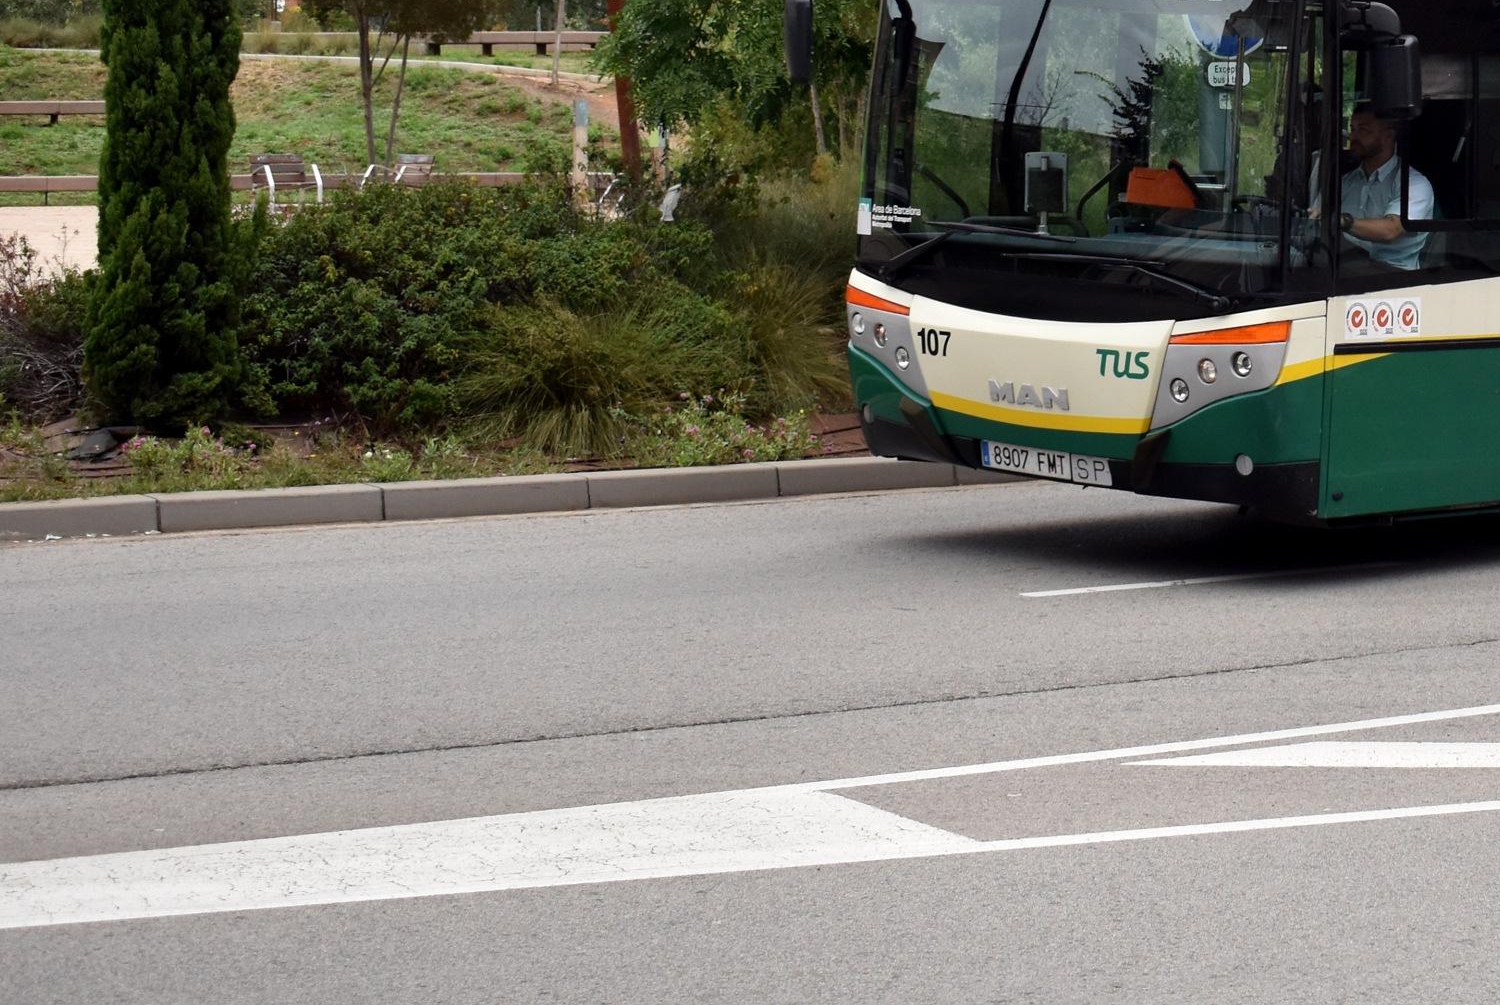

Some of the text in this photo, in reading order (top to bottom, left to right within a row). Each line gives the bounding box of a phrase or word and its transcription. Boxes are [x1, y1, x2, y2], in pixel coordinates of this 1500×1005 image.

[893, 204, 922, 217] Barcelona
[917, 327, 952, 357] 107
[1096, 348, 1151, 380] TUS
[987, 378, 1071, 412] MAN
[993, 445, 1066, 475] 8907 FMT
[1076, 458, 1106, 482] SP
